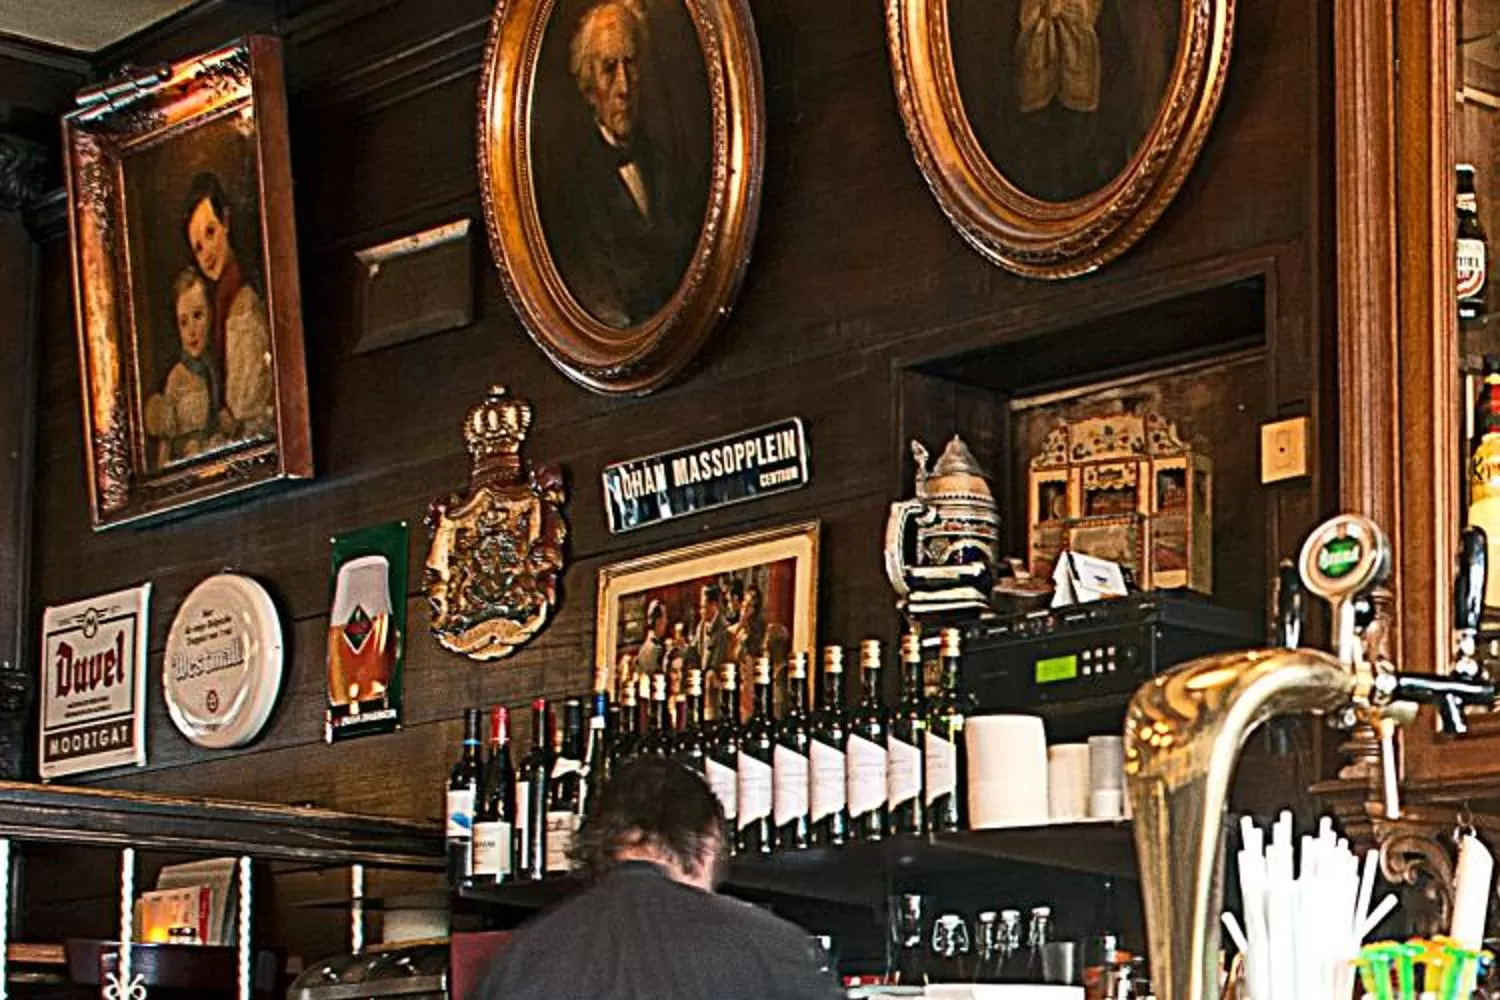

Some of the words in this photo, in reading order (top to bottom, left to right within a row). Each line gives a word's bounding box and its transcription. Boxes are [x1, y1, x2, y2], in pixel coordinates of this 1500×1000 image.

[616, 462, 667, 500] OHAN
[672, 429, 797, 487] MASSOPPLEIN
[759, 466, 799, 488] CENTRUM
[56, 629, 125, 698] Duvel
[50, 725, 129, 756] MOORTGAT
